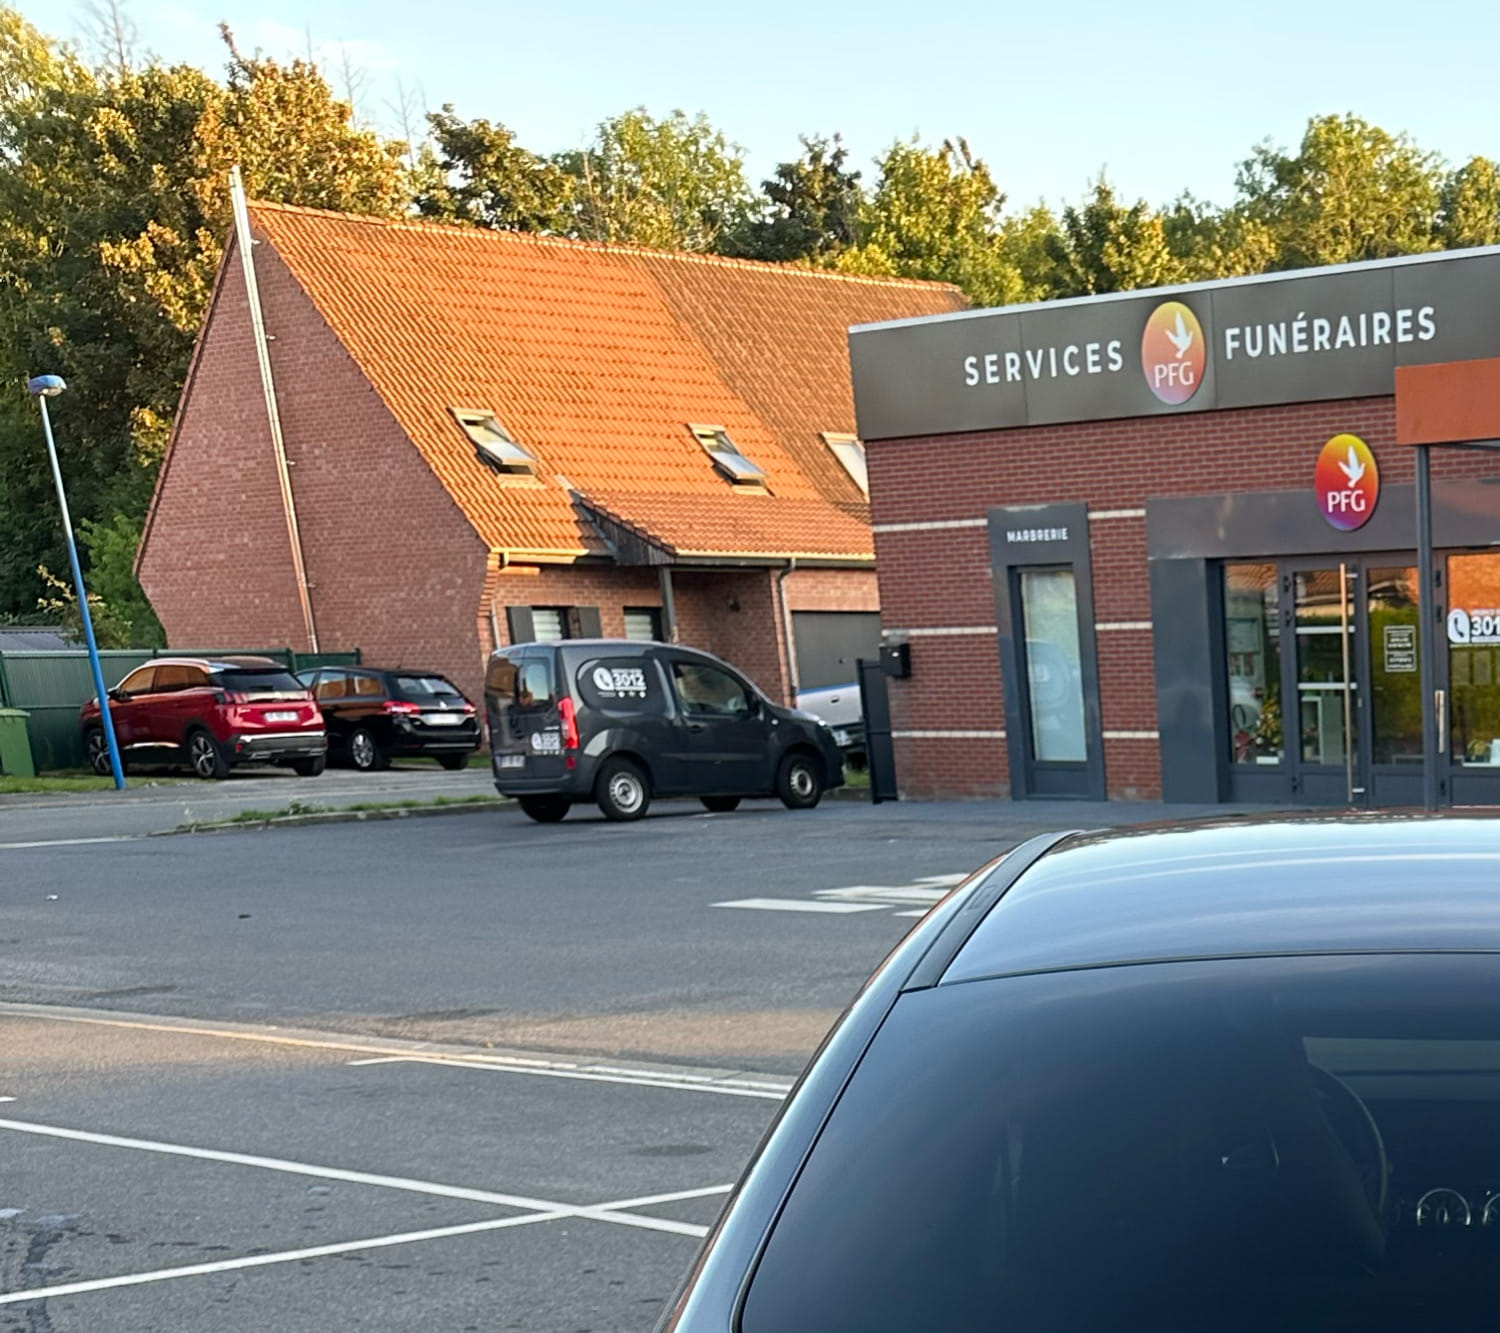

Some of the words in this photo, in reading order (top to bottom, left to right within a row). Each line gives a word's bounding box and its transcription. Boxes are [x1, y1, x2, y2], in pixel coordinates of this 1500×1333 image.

[964, 340, 1123, 386] SERVICES
[1154, 361, 1195, 388] PFG
[1225, 306, 1436, 360] FUNÉRAIRES
[1327, 489, 1366, 513] PFG
[613, 673, 646, 687] 3012
